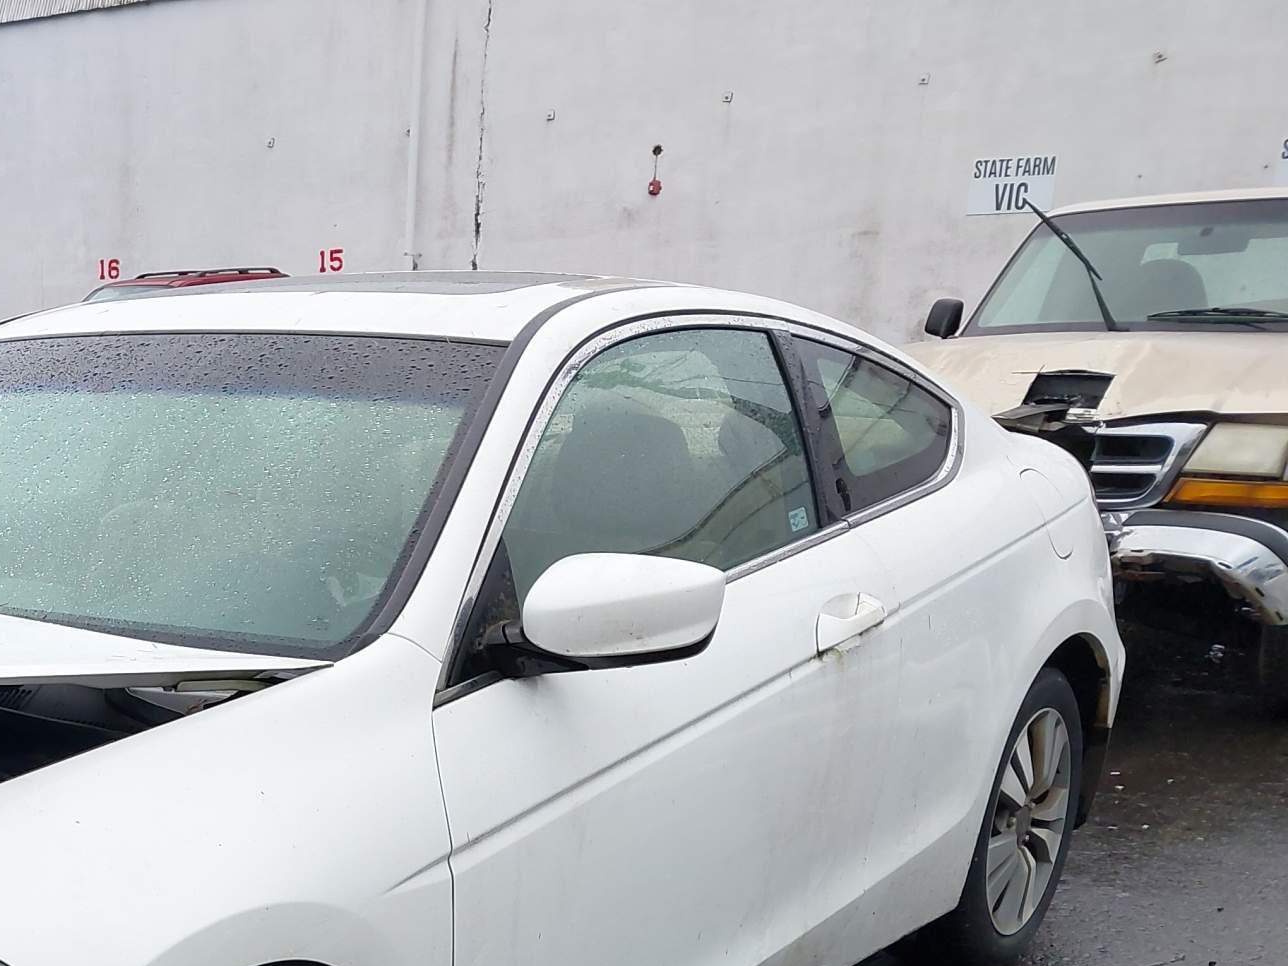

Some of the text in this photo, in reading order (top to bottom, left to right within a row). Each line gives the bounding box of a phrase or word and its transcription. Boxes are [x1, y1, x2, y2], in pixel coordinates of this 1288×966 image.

[974, 156, 1056, 179] STATE FARM
[995, 182, 1029, 211] VIC
[98, 259, 121, 280] 16
[318, 248, 344, 273] 15
